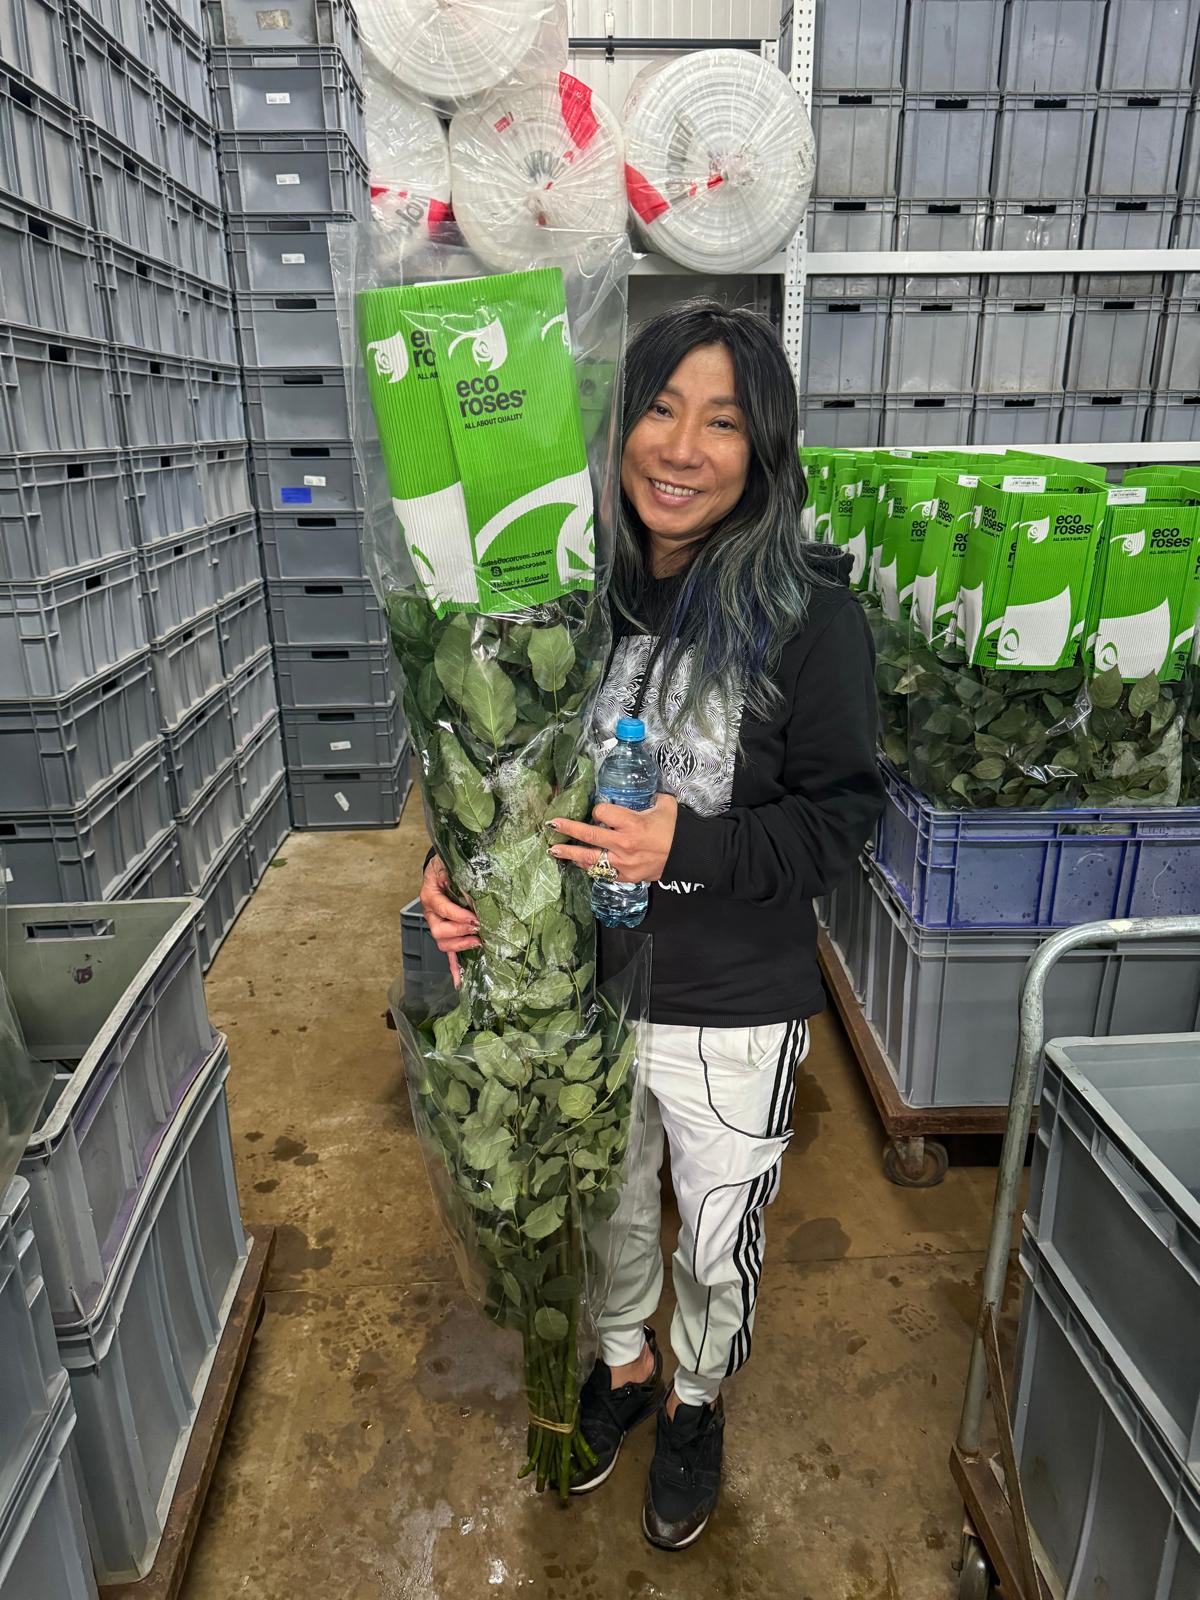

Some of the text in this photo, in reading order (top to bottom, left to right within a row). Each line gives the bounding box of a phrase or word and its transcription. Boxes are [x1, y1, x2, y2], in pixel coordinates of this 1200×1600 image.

[456, 375, 499, 398] eco
[459, 390, 524, 417] roses
[464, 413, 523, 430] ALL ABOUT QUALITY
[984, 506, 996, 518] eco
[982, 516, 1004, 532] roses
[1056, 514, 1082, 525] eco
[1054, 524, 1092, 536] roses
[1152, 528, 1180, 538] eco
[1150, 537, 1191, 548] roses
[524, 573, 549, 582] Ecuador
